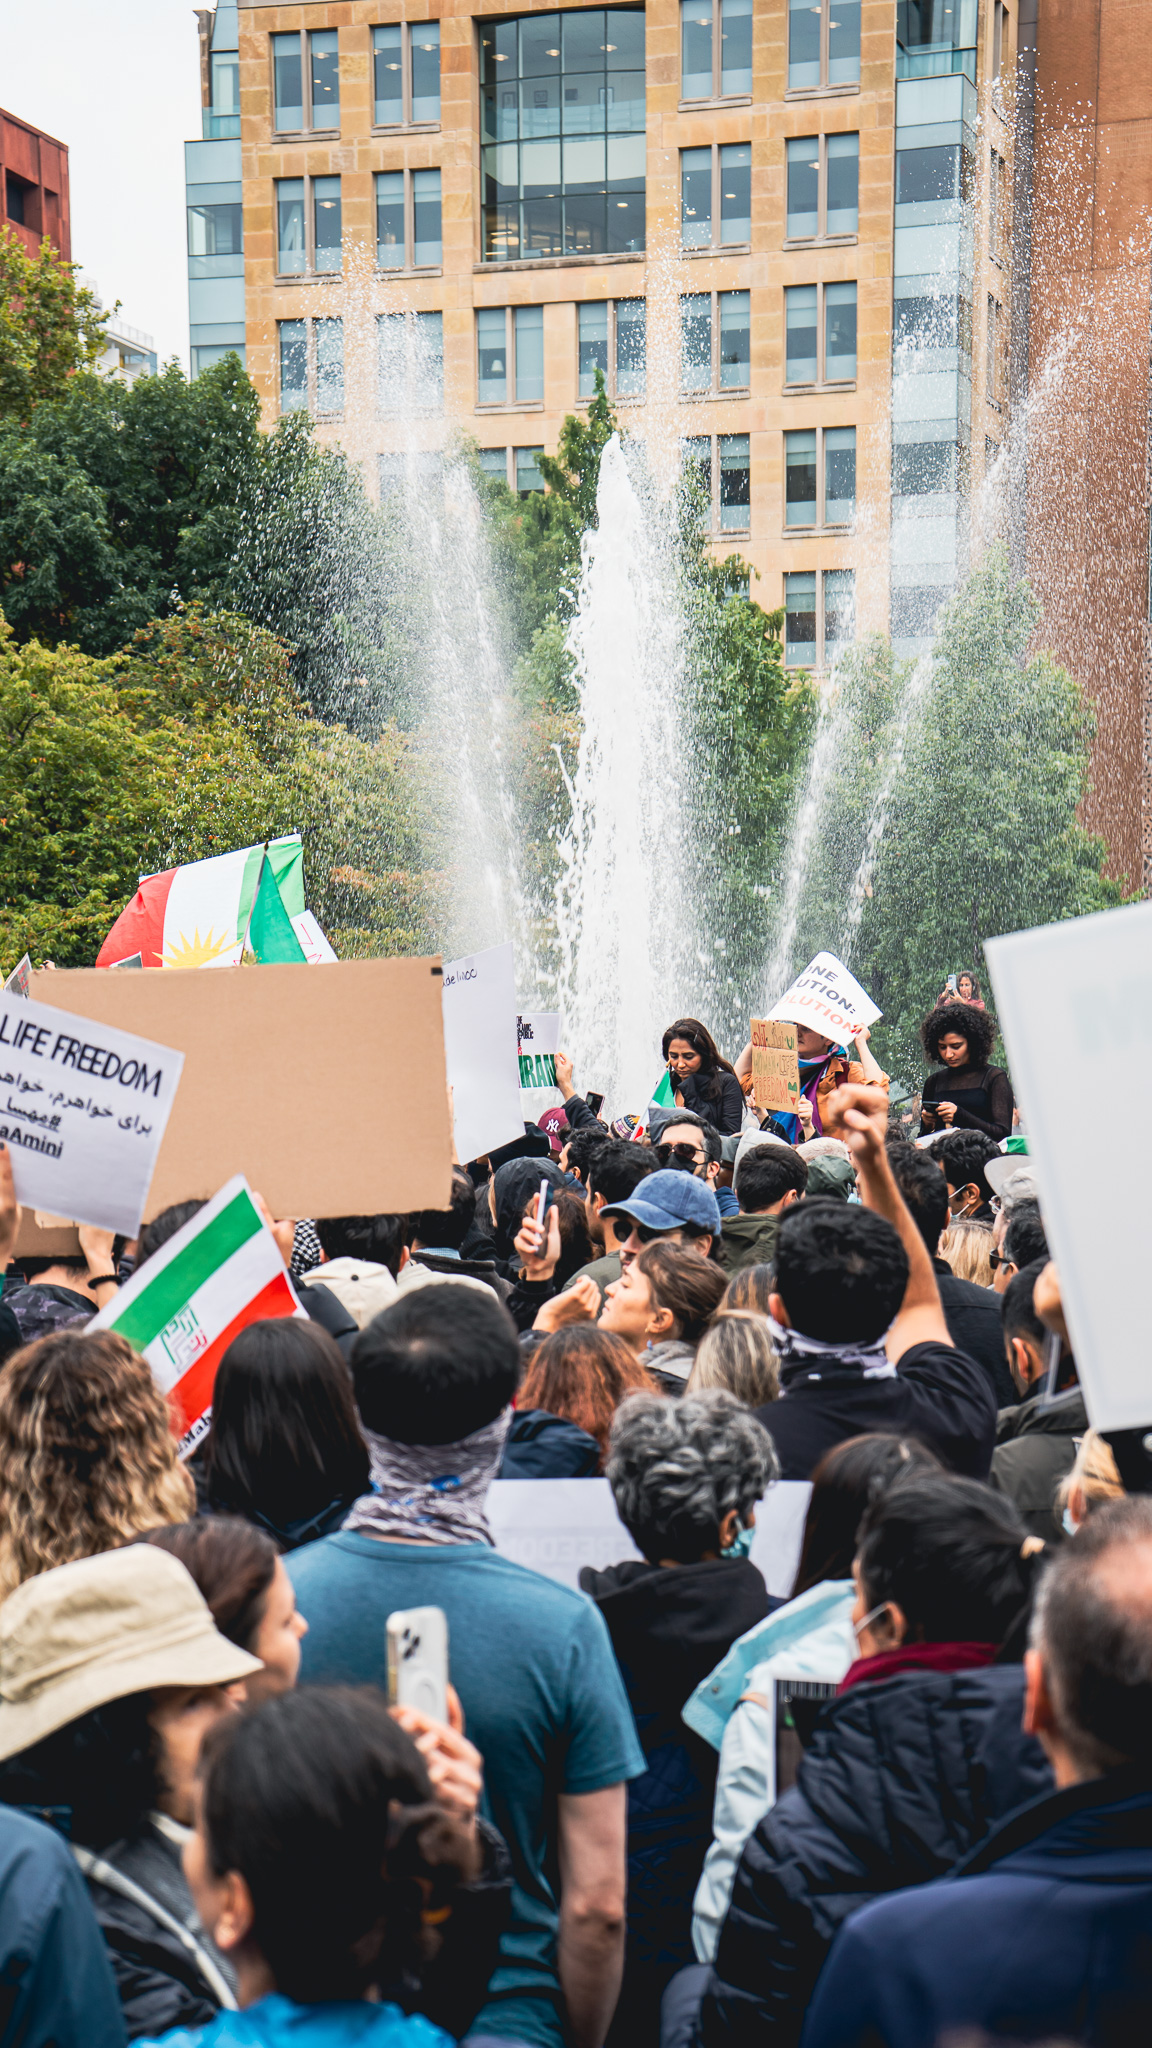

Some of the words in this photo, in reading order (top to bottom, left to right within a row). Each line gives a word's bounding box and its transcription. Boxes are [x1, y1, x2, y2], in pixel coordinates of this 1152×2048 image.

[796, 979, 856, 1014] UTION:
[0, 1014, 52, 1057] LIFE
[51, 1034, 163, 1098] FREEDOM
[0, 1125, 64, 1160] aAmini
